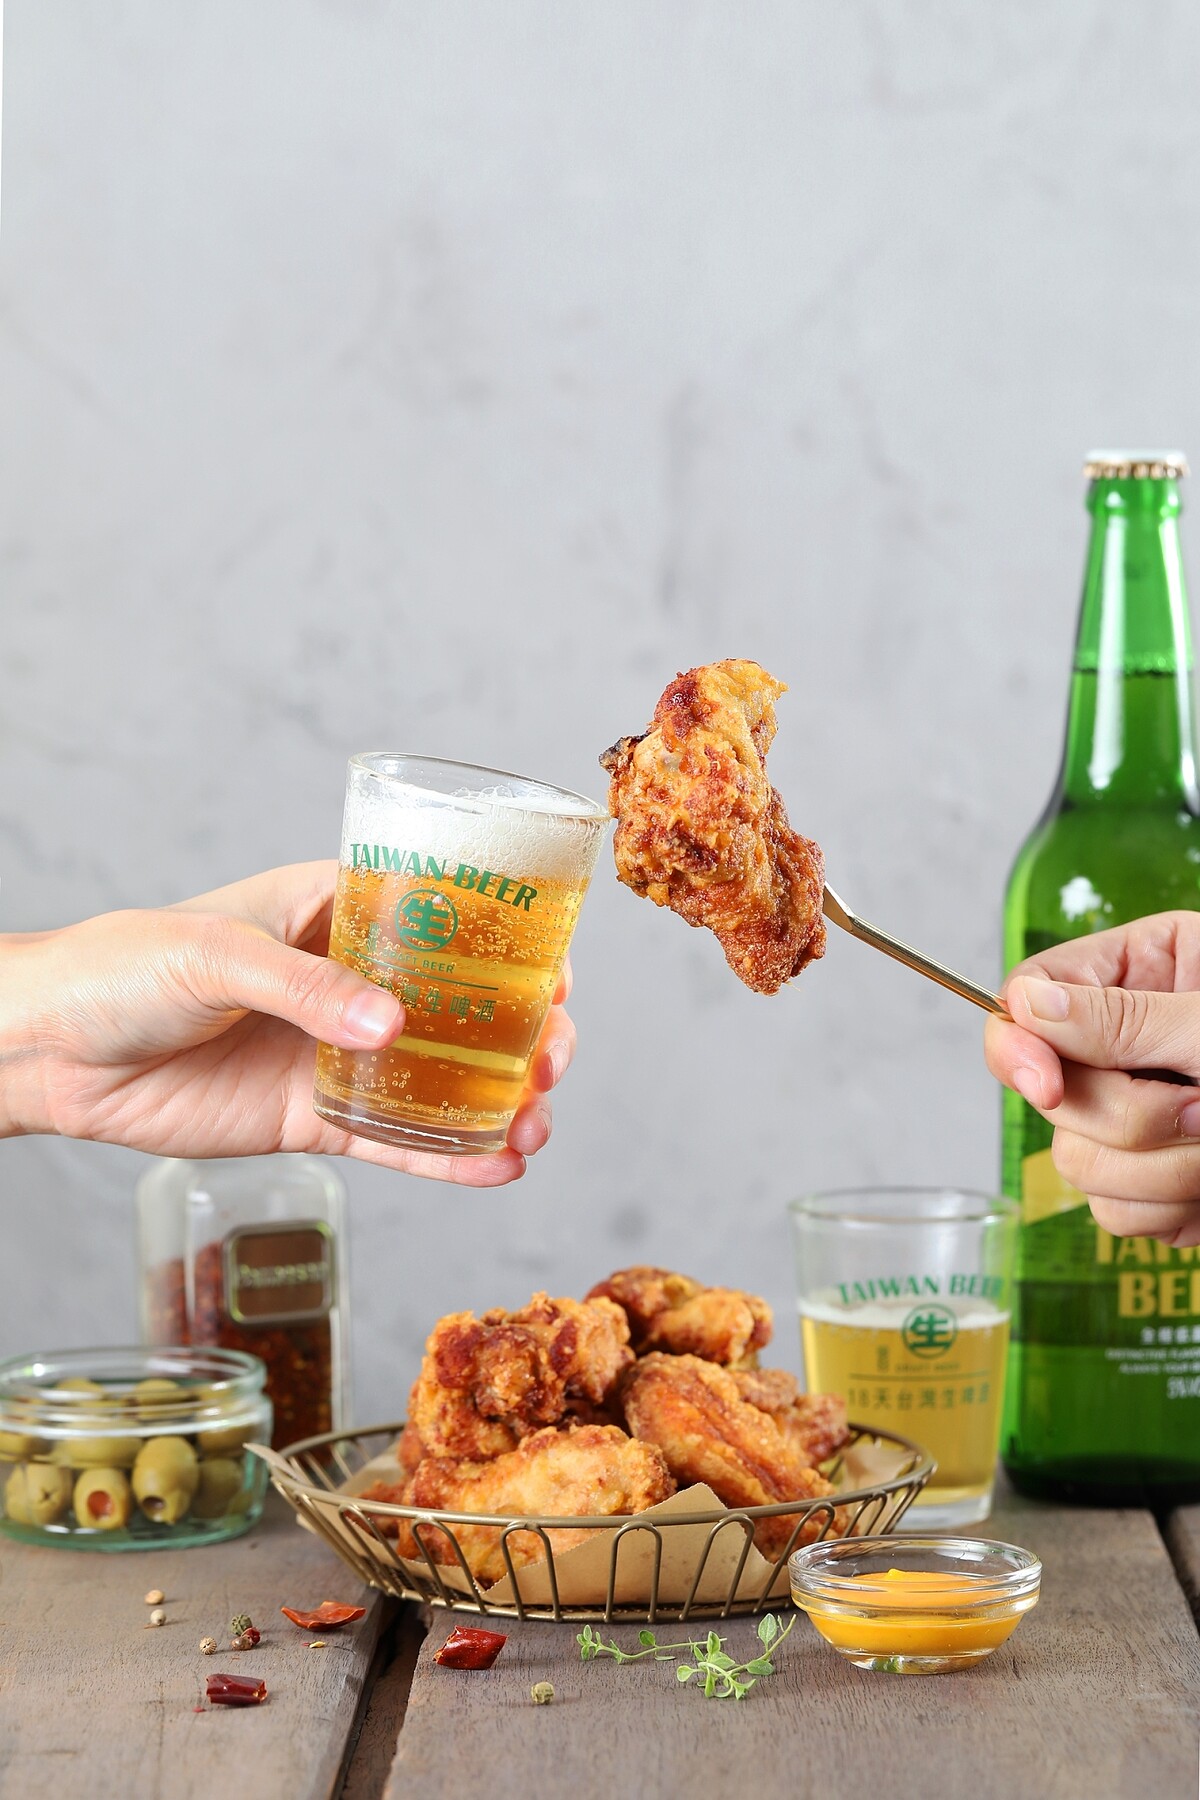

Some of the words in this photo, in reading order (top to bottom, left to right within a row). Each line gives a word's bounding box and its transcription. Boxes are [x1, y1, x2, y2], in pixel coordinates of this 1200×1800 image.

[350, 843, 447, 882] TAIWAN
[453, 863, 538, 912] BEER
[397, 894, 453, 950] 生
[423, 959, 454, 973] BEER
[835, 1274, 939, 1304] TAIWAN
[907, 1311, 953, 1351] 生
